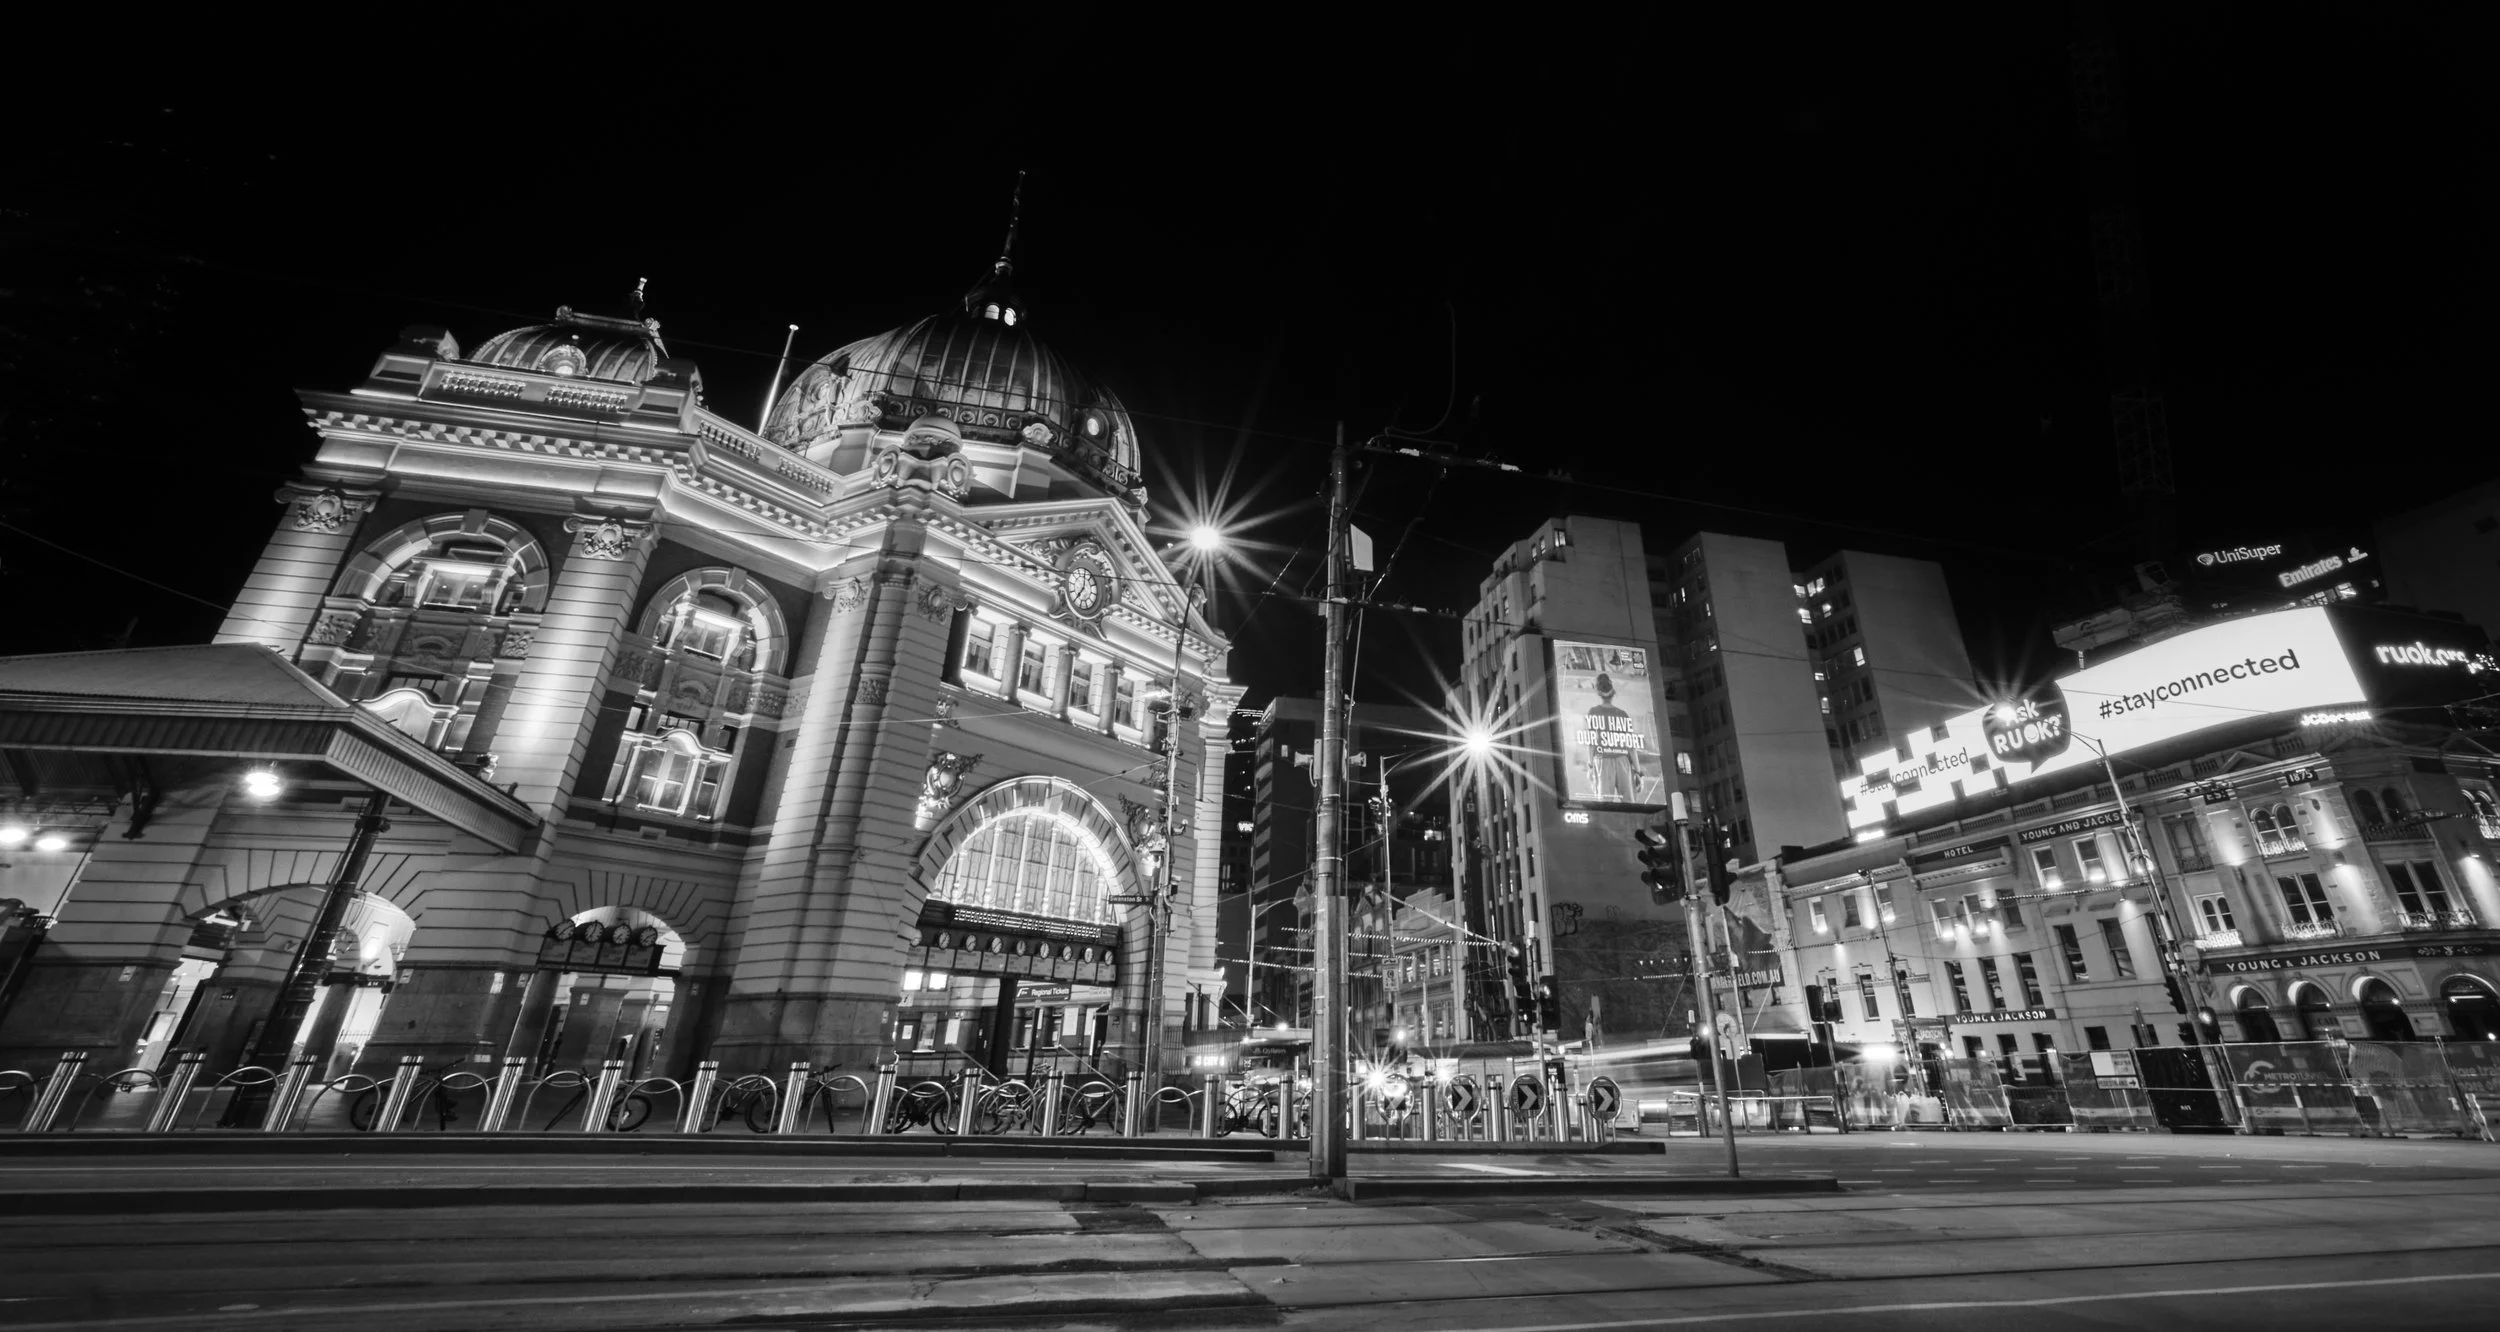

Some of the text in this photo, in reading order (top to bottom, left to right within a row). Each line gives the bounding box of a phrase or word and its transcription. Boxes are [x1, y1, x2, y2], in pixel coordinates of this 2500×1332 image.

[2214, 544, 2282, 564] UniSuper
[2278, 555, 2343, 588] Emirates
[2099, 648, 2300, 720] #stayconnected
[1585, 715, 1634, 733] YOU HAVE
[1576, 730, 1646, 750] OUR SUPPORT
[2288, 769, 2314, 783] 1875
[2021, 812, 2121, 841] YOUNG AND JACKS
[1943, 845, 1974, 860] HOTEL
[2226, 950, 2382, 973] YOUNG & JACKSON
[1955, 1014, 1988, 1024] YOUNG
[1998, 1010, 2047, 1022] JACKSON
